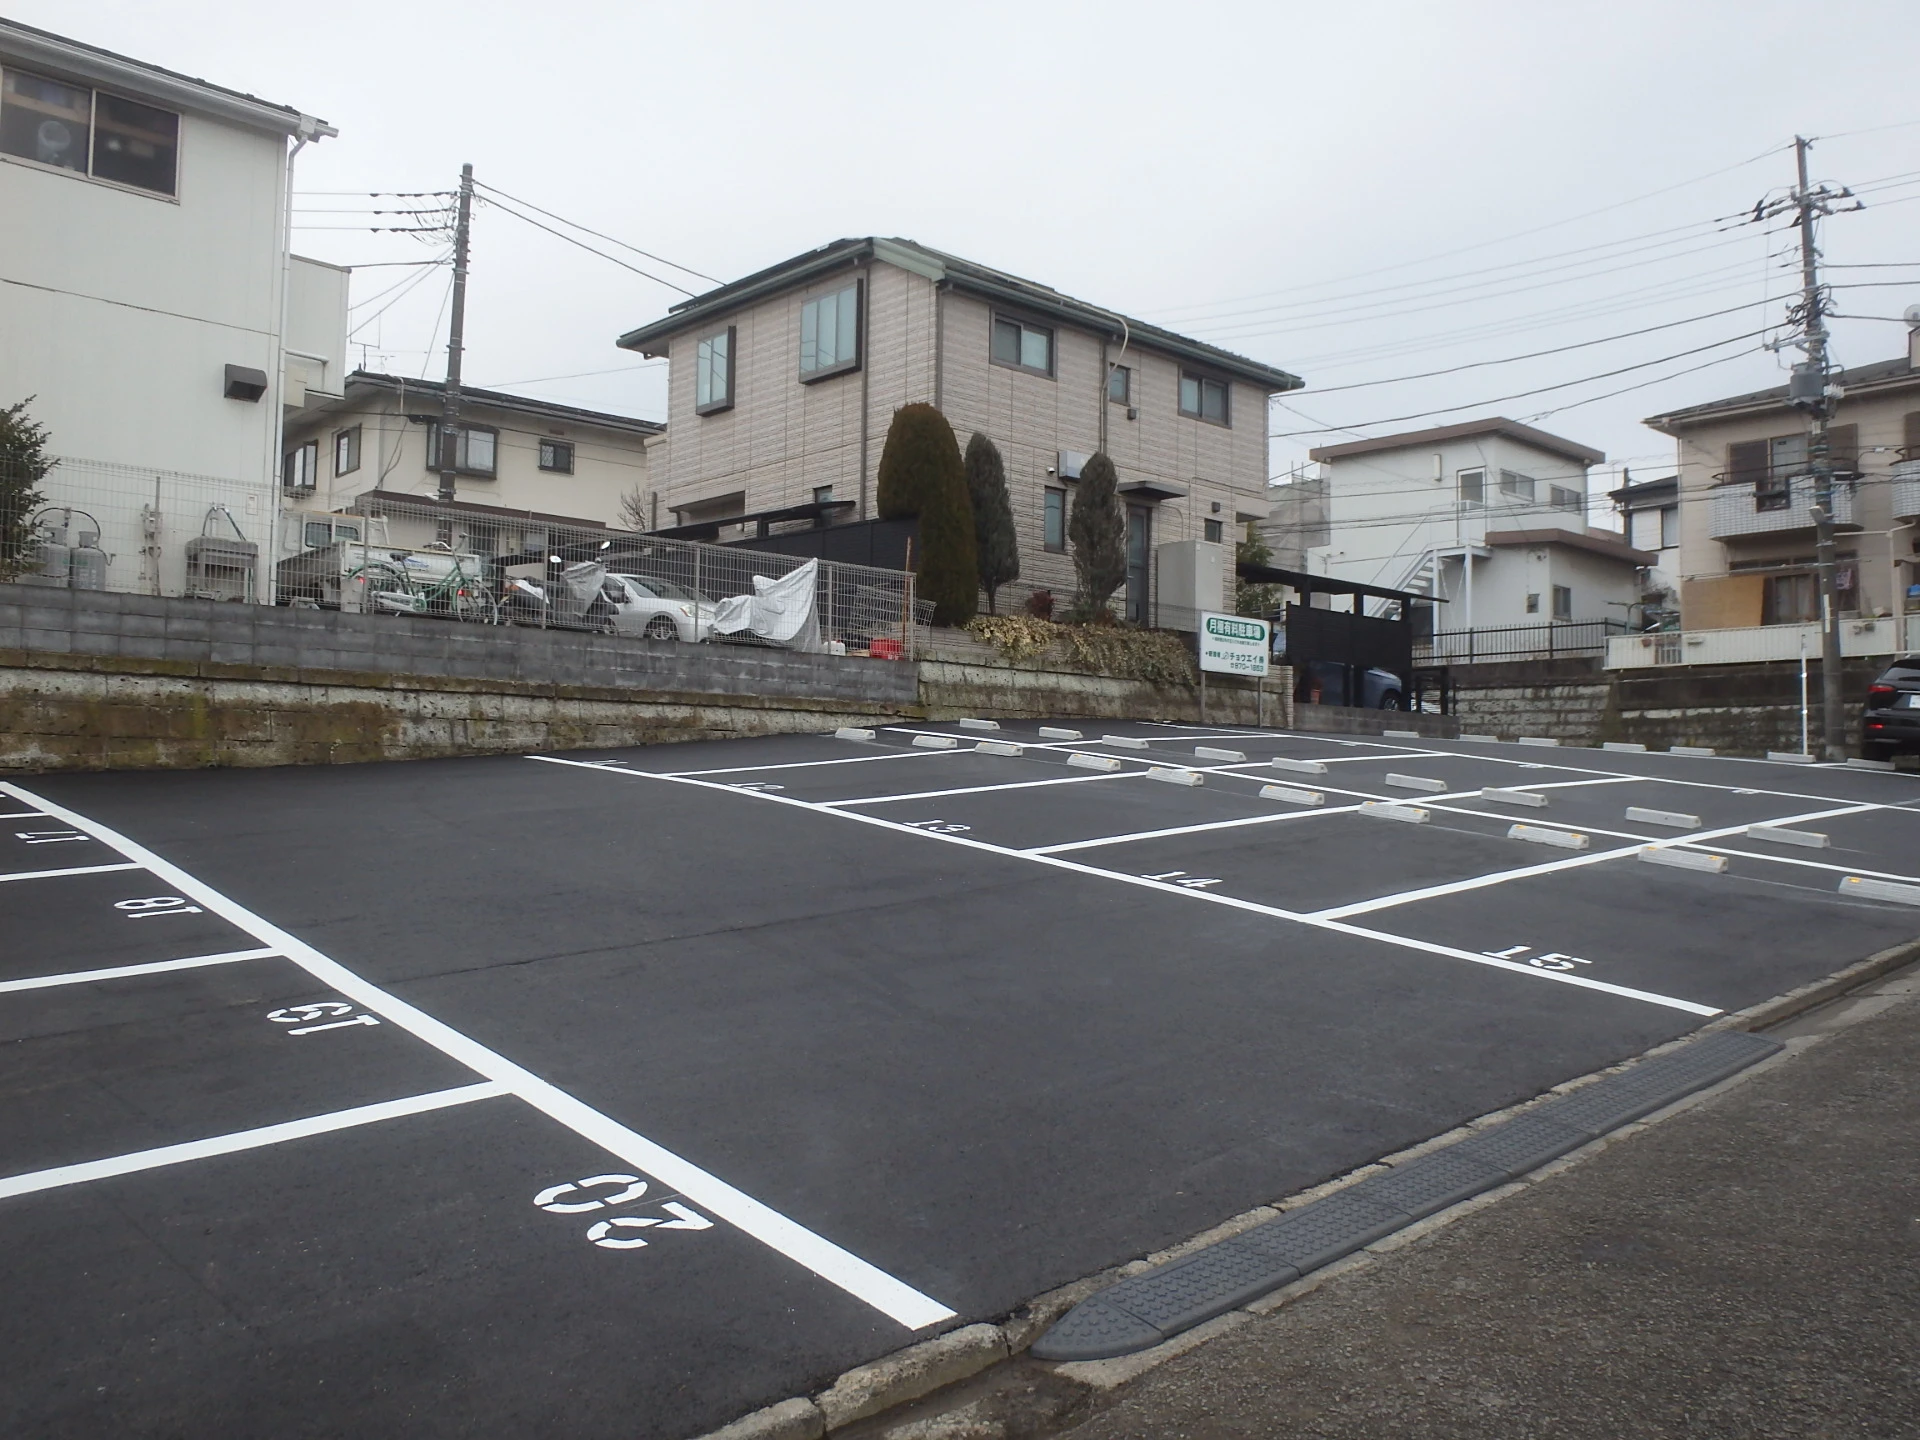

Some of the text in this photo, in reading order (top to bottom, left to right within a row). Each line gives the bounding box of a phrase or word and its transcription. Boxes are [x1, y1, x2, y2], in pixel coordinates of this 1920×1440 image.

[15, 830, 90, 844] 17
[902, 819, 971, 833] 13
[1140, 871, 1224, 888] 14
[114, 896, 203, 918] 18
[1481, 945, 1593, 970] 15
[267, 1002, 381, 1035] 19
[533, 1173, 715, 1250] 20
